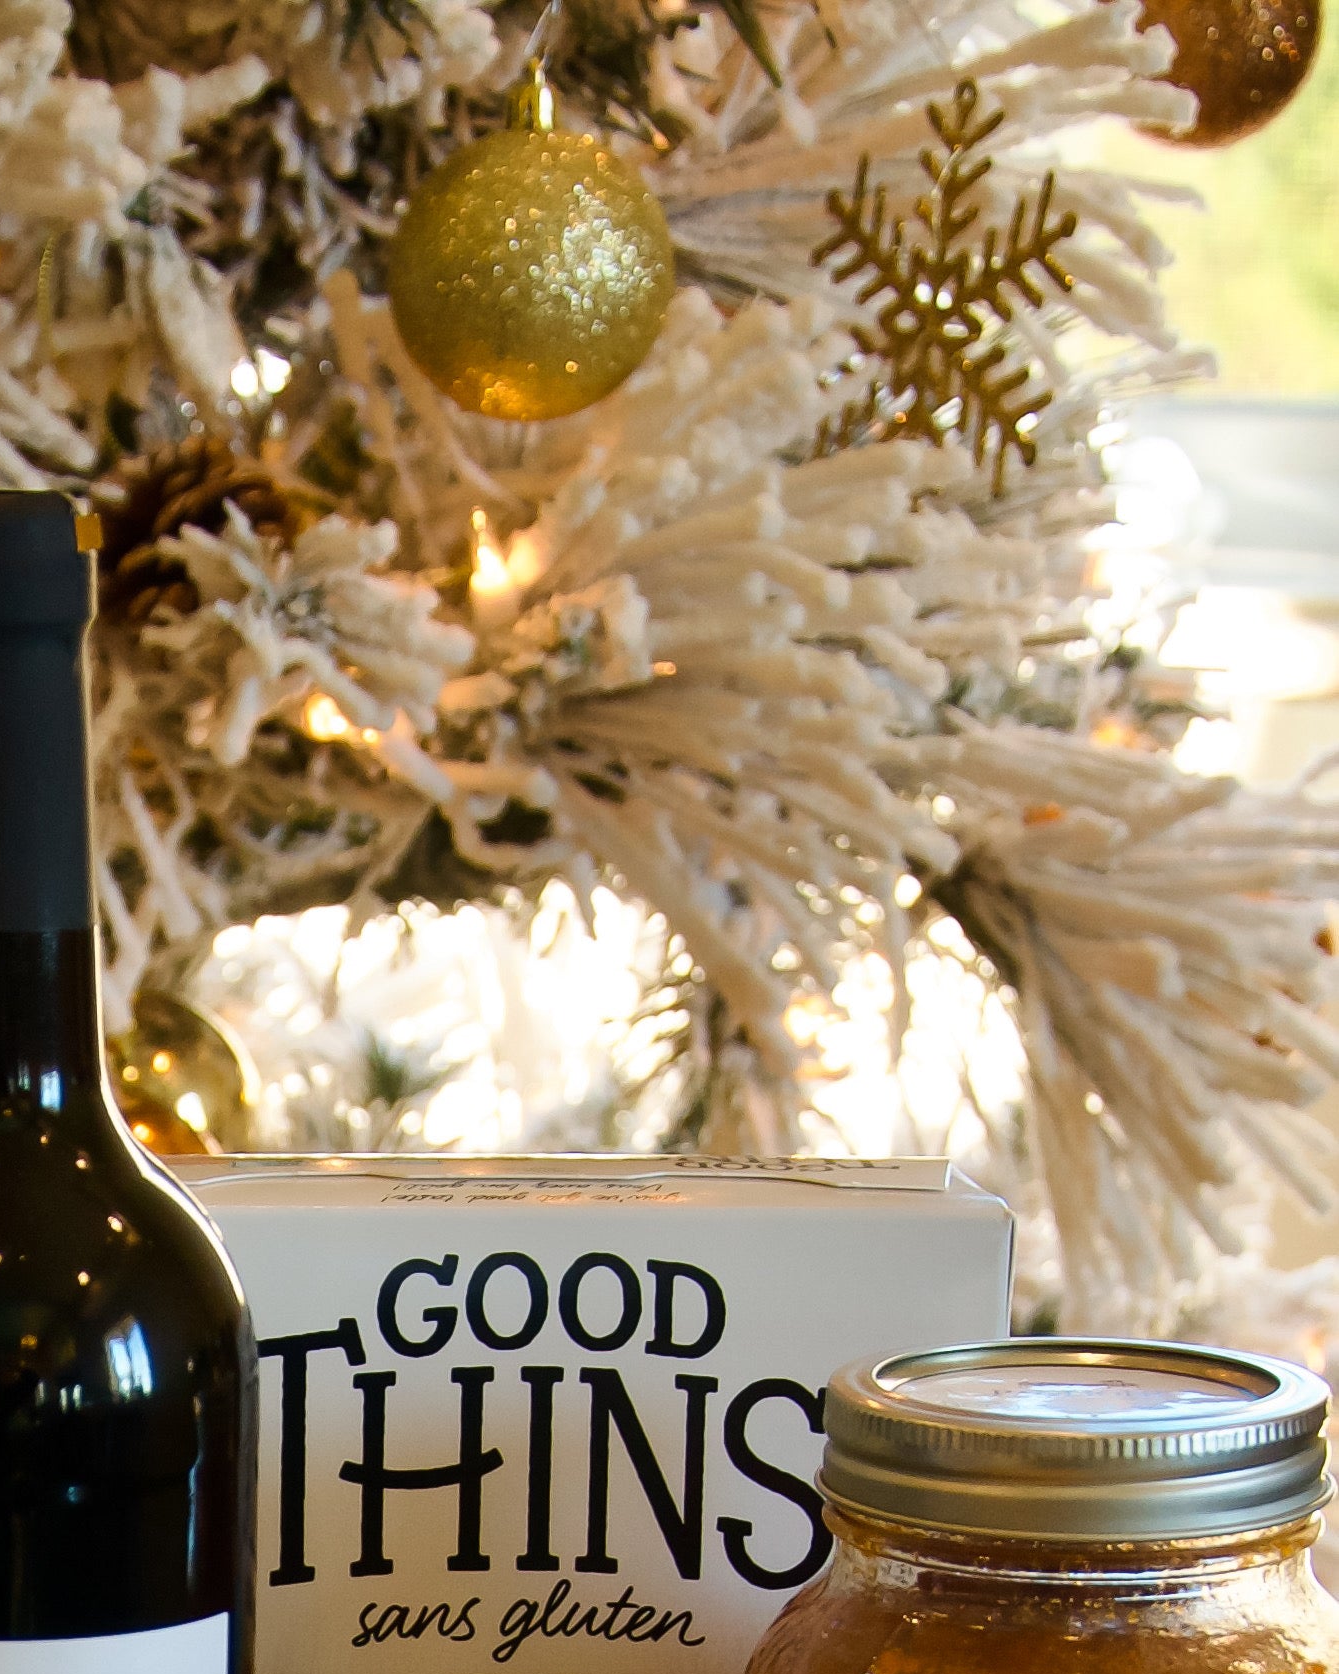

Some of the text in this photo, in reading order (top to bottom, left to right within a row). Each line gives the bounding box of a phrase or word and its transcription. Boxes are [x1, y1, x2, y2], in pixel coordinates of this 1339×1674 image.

[376, 1251, 727, 1359] GOOD
[257, 1317, 836, 1590] THINS
[351, 1577, 706, 1664] sans gluten
